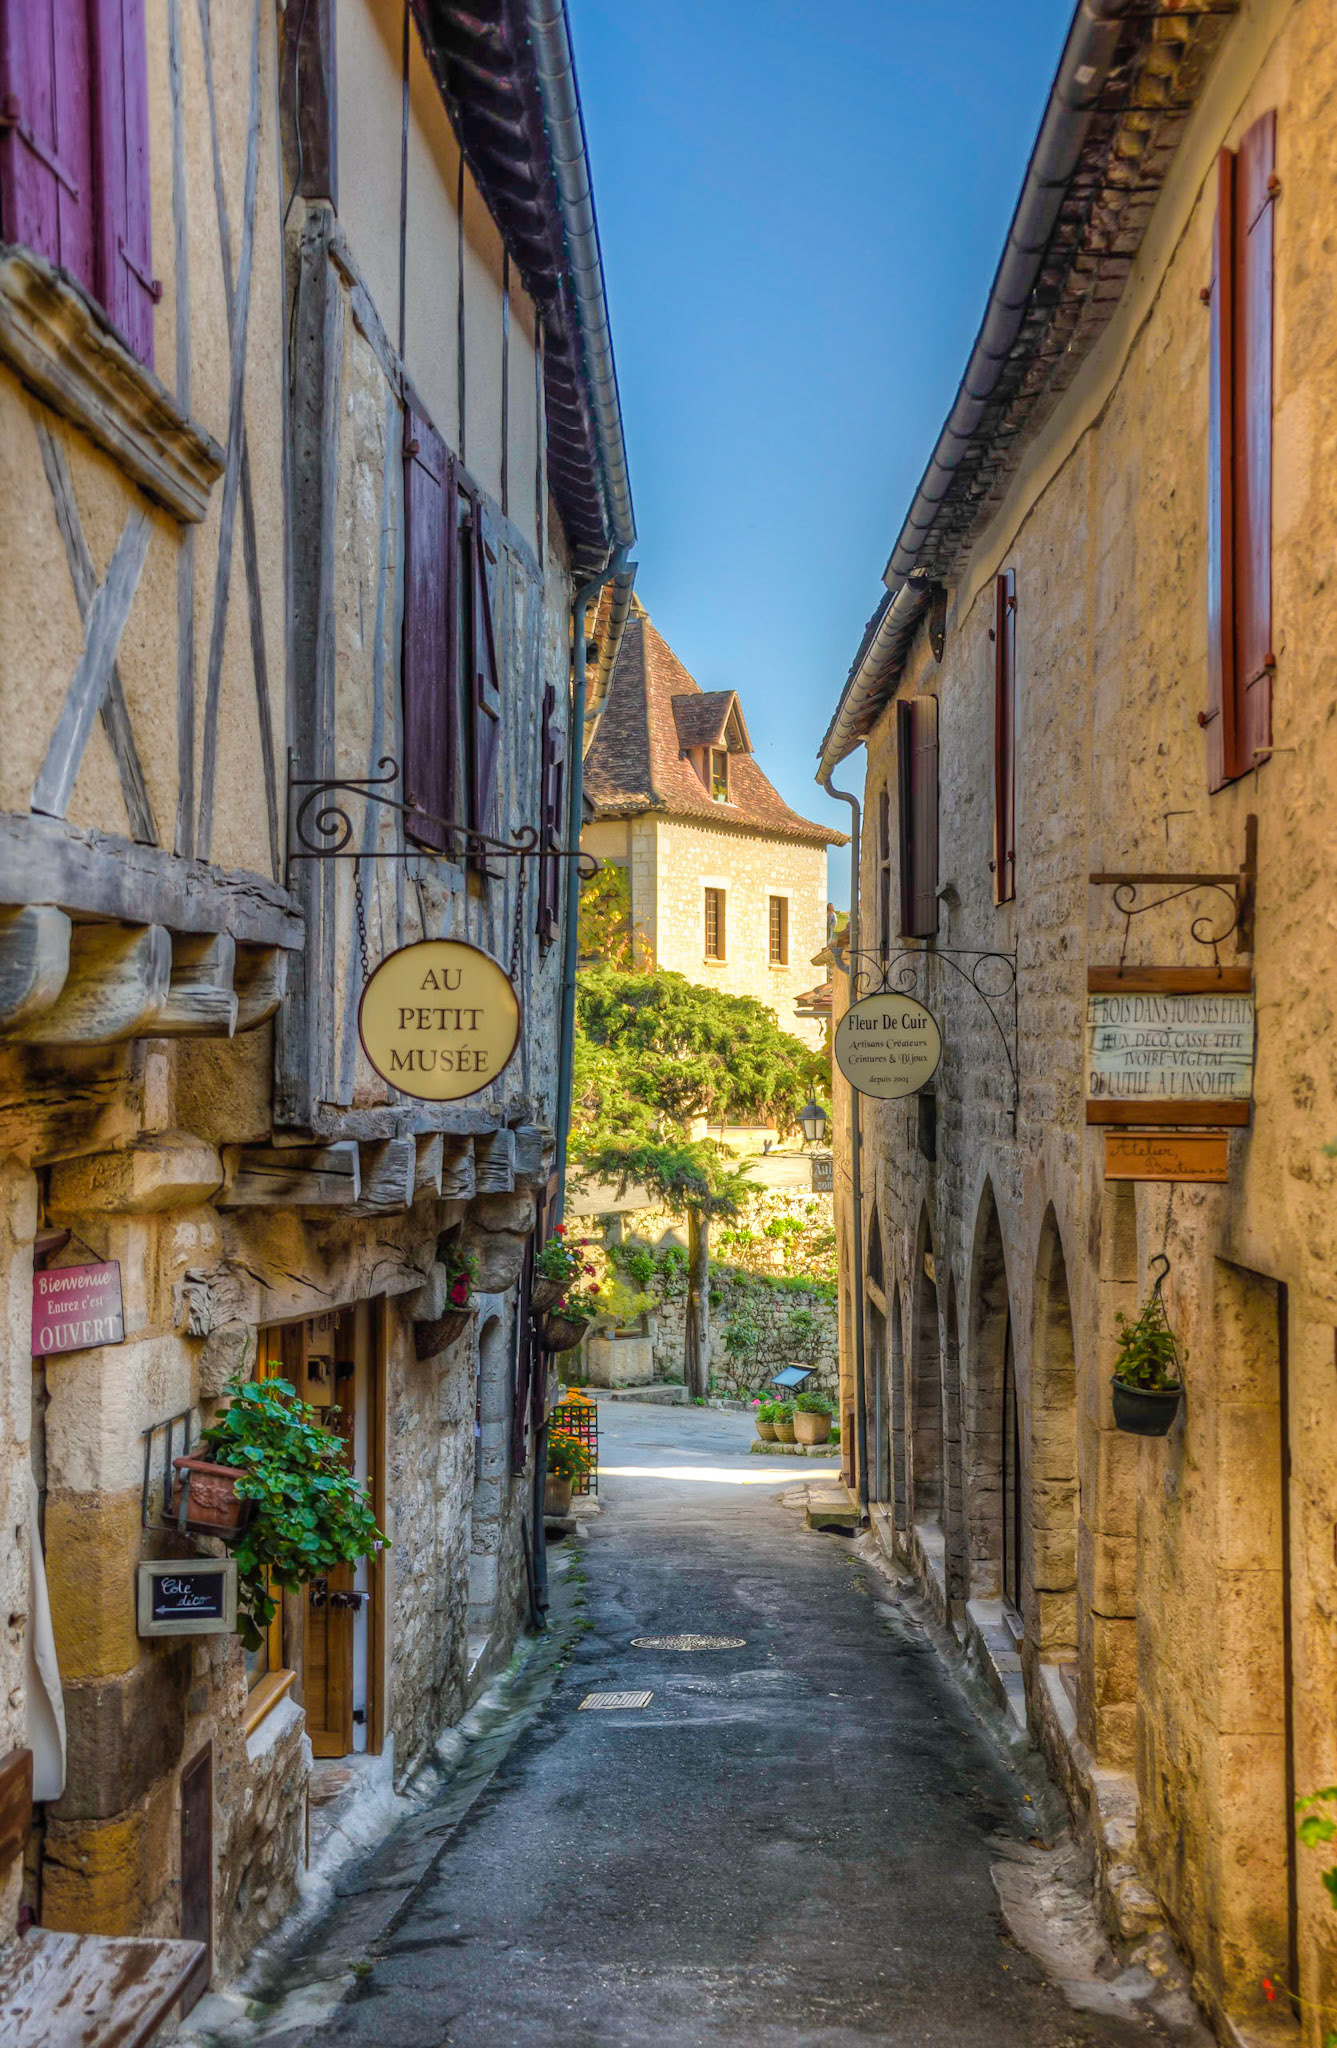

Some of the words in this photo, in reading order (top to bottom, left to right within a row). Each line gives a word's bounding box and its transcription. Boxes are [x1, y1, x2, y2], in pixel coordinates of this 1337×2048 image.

[420, 968, 462, 991] AU
[398, 1008, 484, 1031] PETIT
[1086, 997, 1098, 1023] LE
[1102, 997, 1131, 1023] BOIS
[1134, 997, 1169, 1023] DANS
[1171, 998, 1200, 1023] TOUS
[1201, 998, 1219, 1023] SES
[848, 1014, 878, 1031] Fleur
[882, 1014, 898, 1030] De
[902, 1013, 927, 1030] Cuir
[848, 1040, 885, 1050] Artisans
[389, 1044, 489, 1073] MUSÉE
[848, 1054, 887, 1064] Ceintures
[889, 1054, 897, 1064] &
[898, 1053, 928, 1065] Bijoux
[869, 1075, 891, 1085] depuis
[1090, 1071, 1105, 1094] DE
[39, 1271, 112, 1295] Bienvenue
[47, 1300, 79, 1315] Entrez
[81, 1294, 104, 1309] c'est
[40, 1316, 117, 1351] OUVERT
